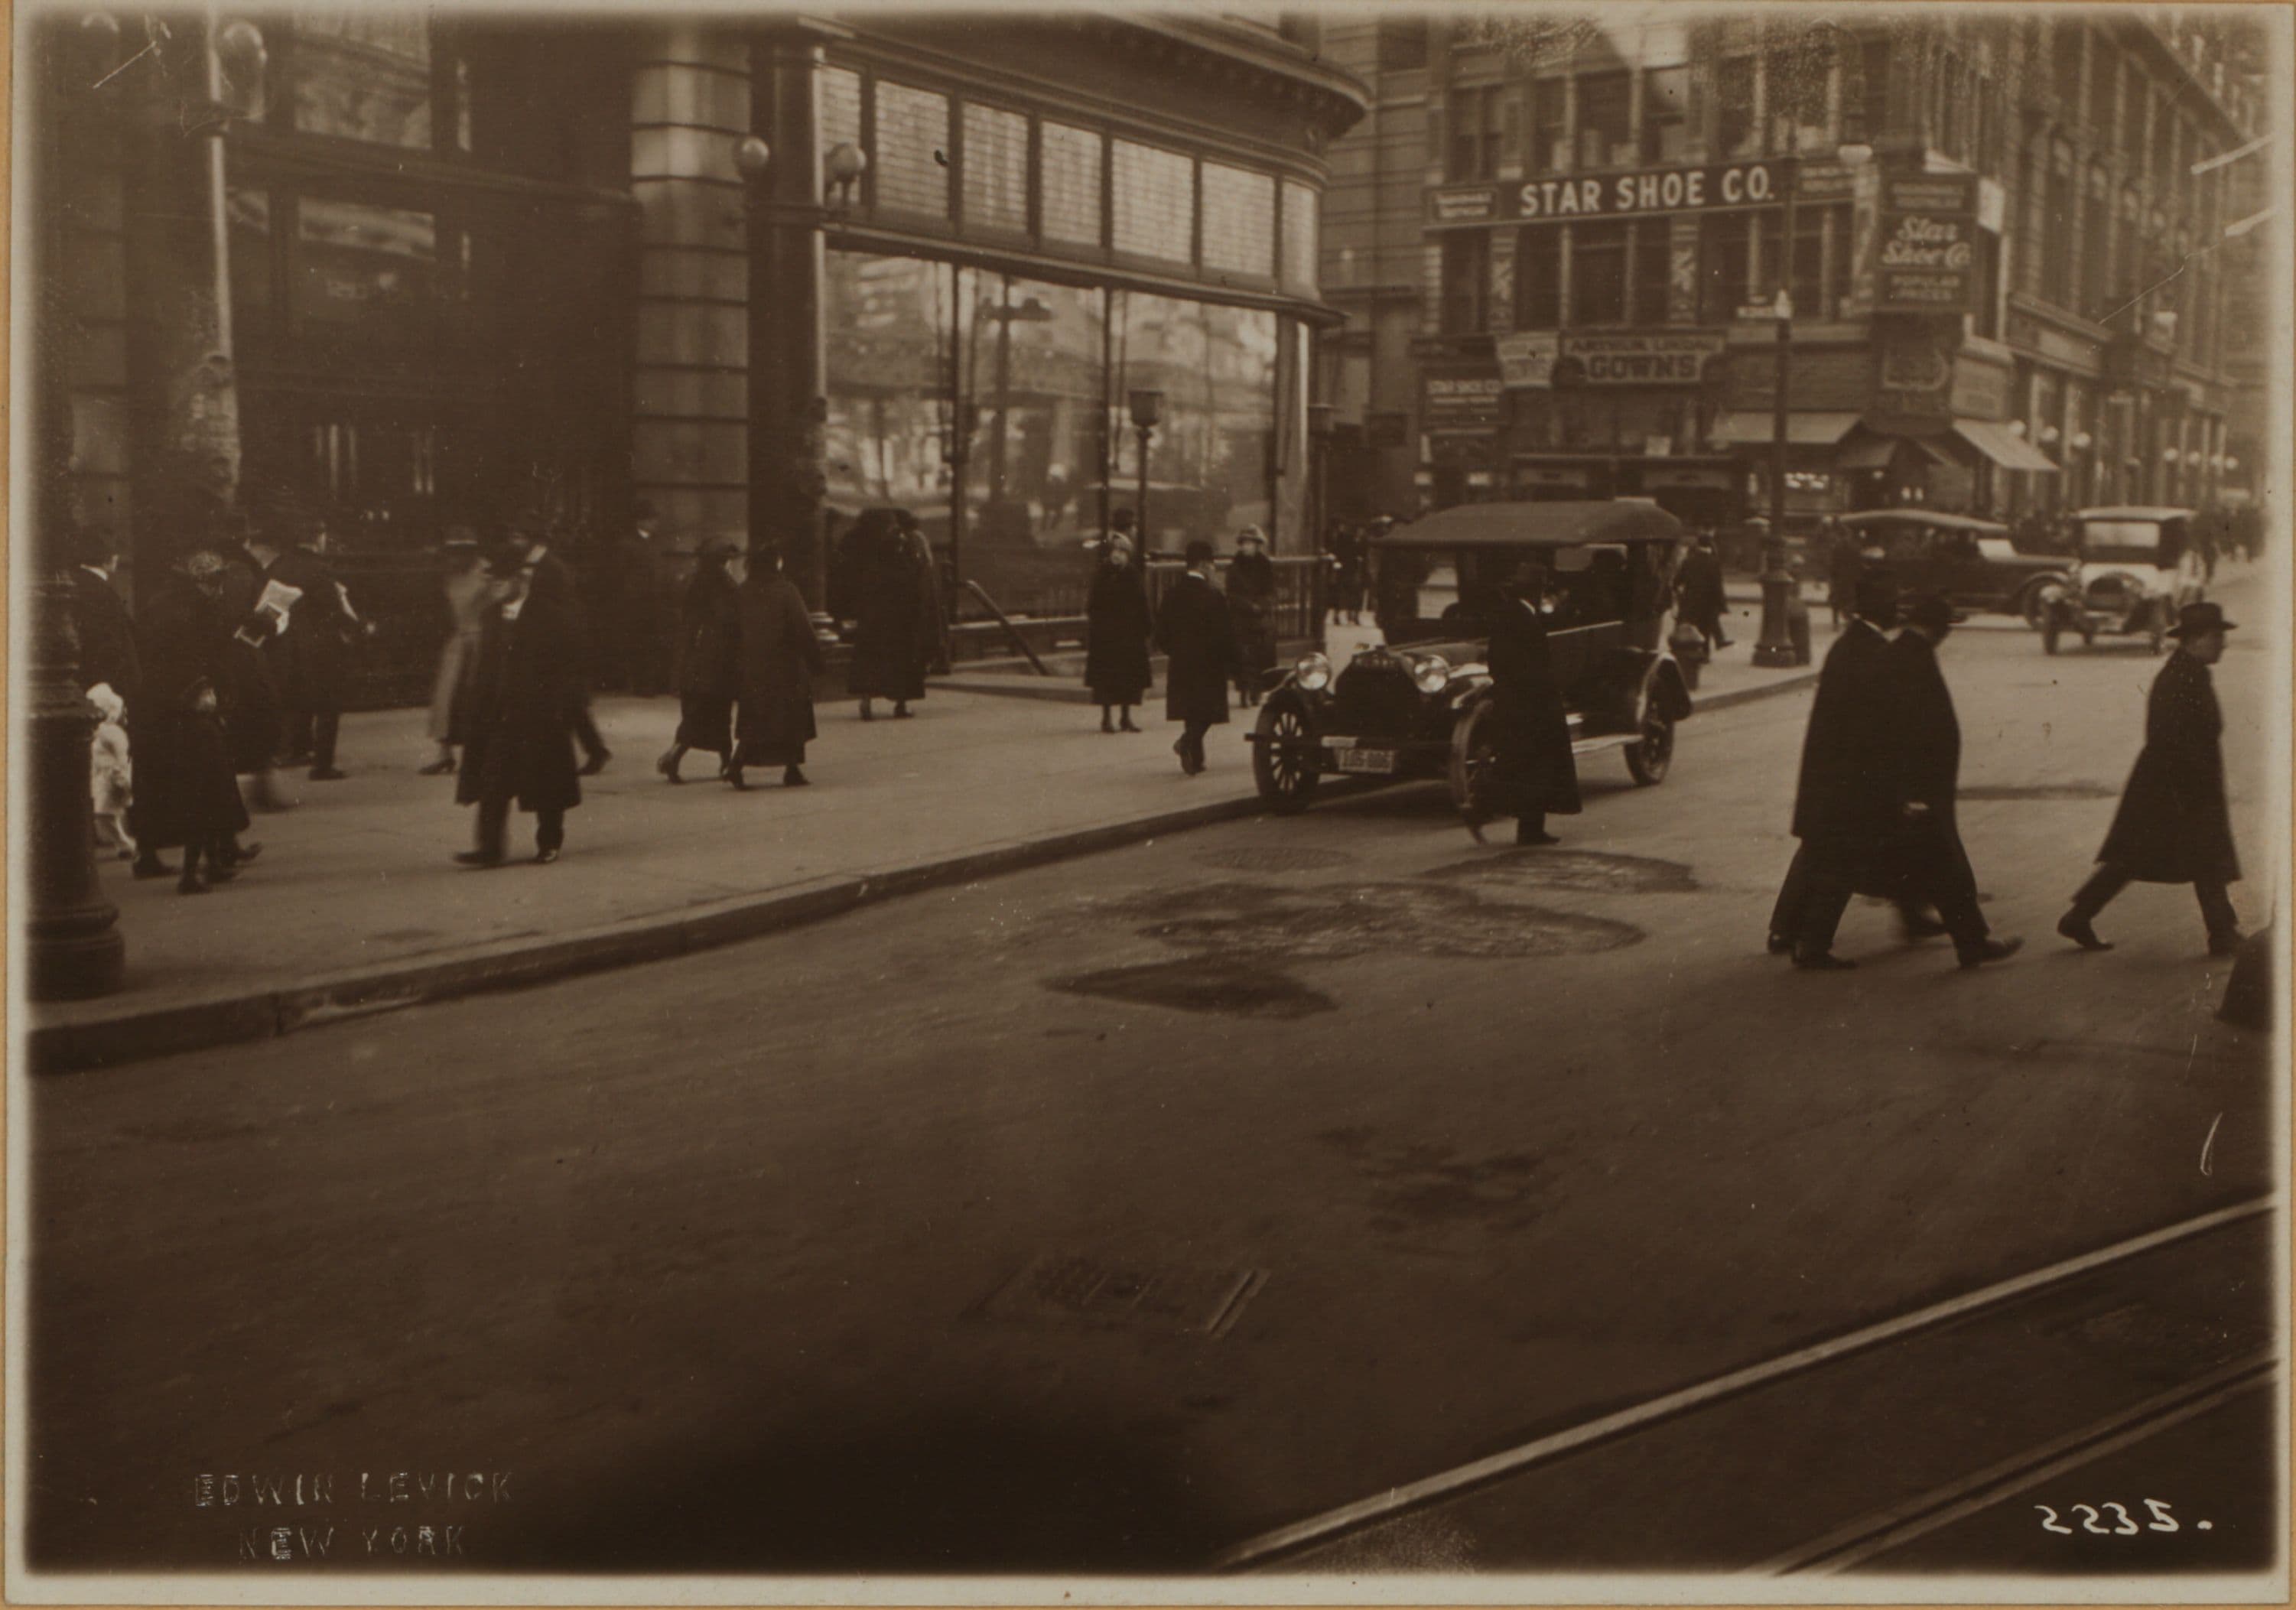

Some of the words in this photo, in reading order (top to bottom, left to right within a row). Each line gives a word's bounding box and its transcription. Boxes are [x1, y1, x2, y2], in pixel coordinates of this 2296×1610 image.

[1519, 178, 1603, 217] STAR
[1615, 170, 1707, 211] SHOE
[1720, 164, 1776, 204] CO.
[1589, 354, 1696, 379] GOWNS
